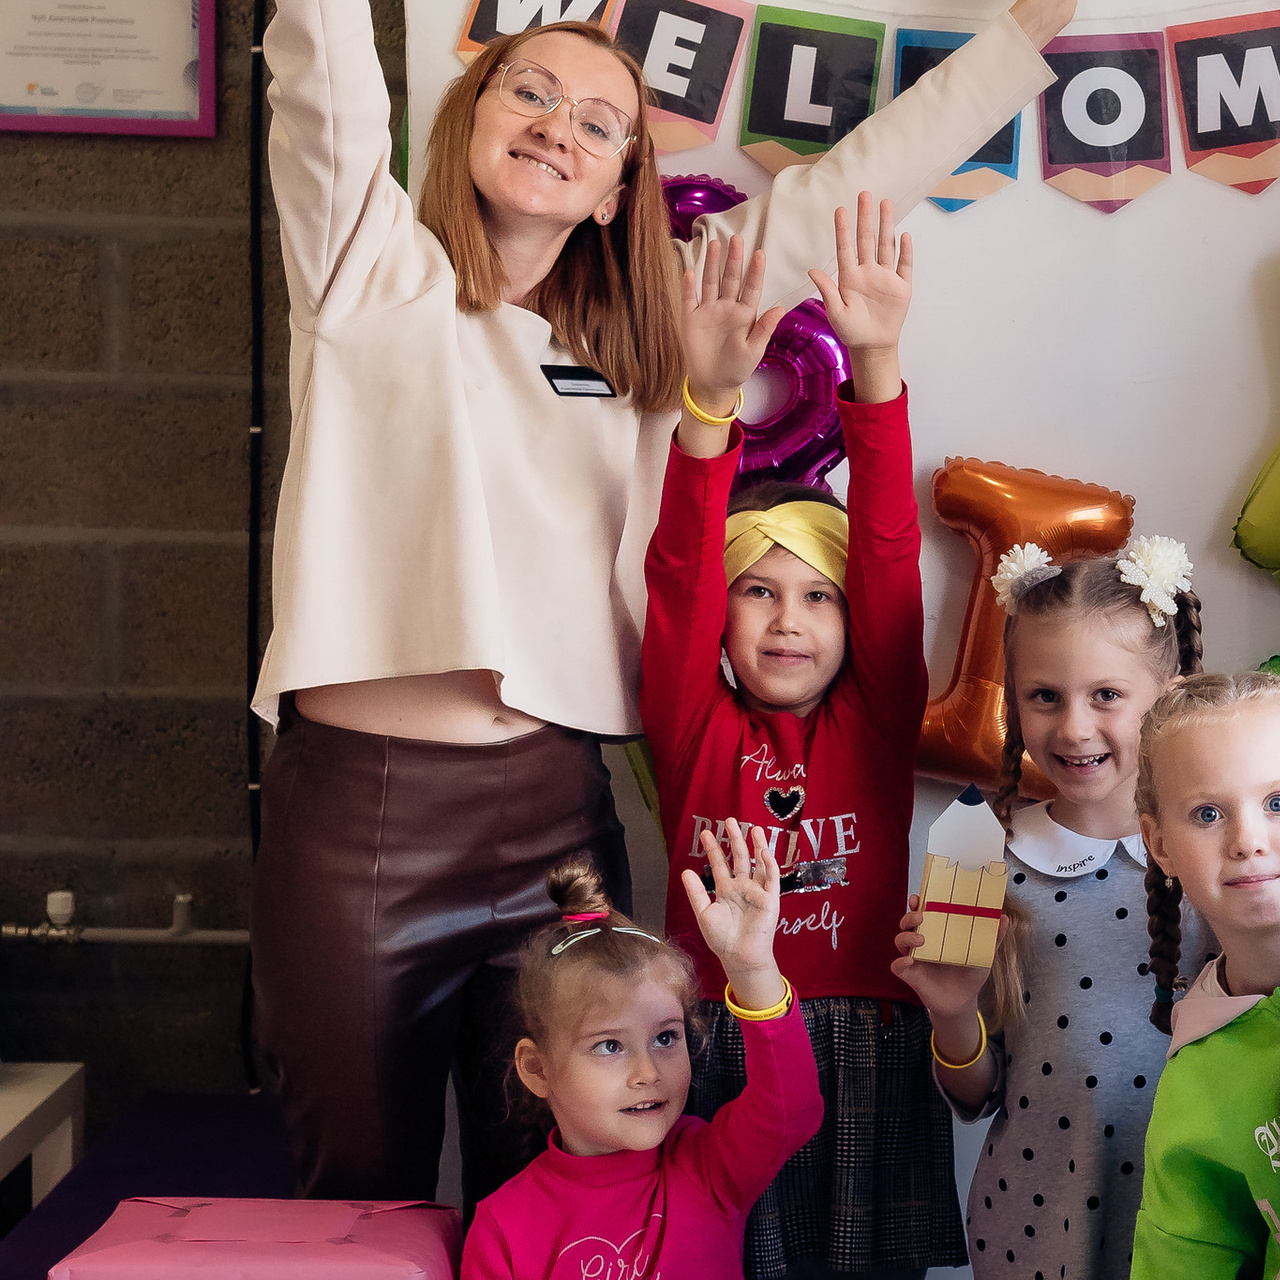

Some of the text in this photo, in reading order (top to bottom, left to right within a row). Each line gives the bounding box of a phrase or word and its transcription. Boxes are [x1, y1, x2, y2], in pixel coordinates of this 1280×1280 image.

[740, 742, 808, 782] Alwa
[1056, 855, 1095, 873] Inspire
[775, 900, 845, 950] rself
